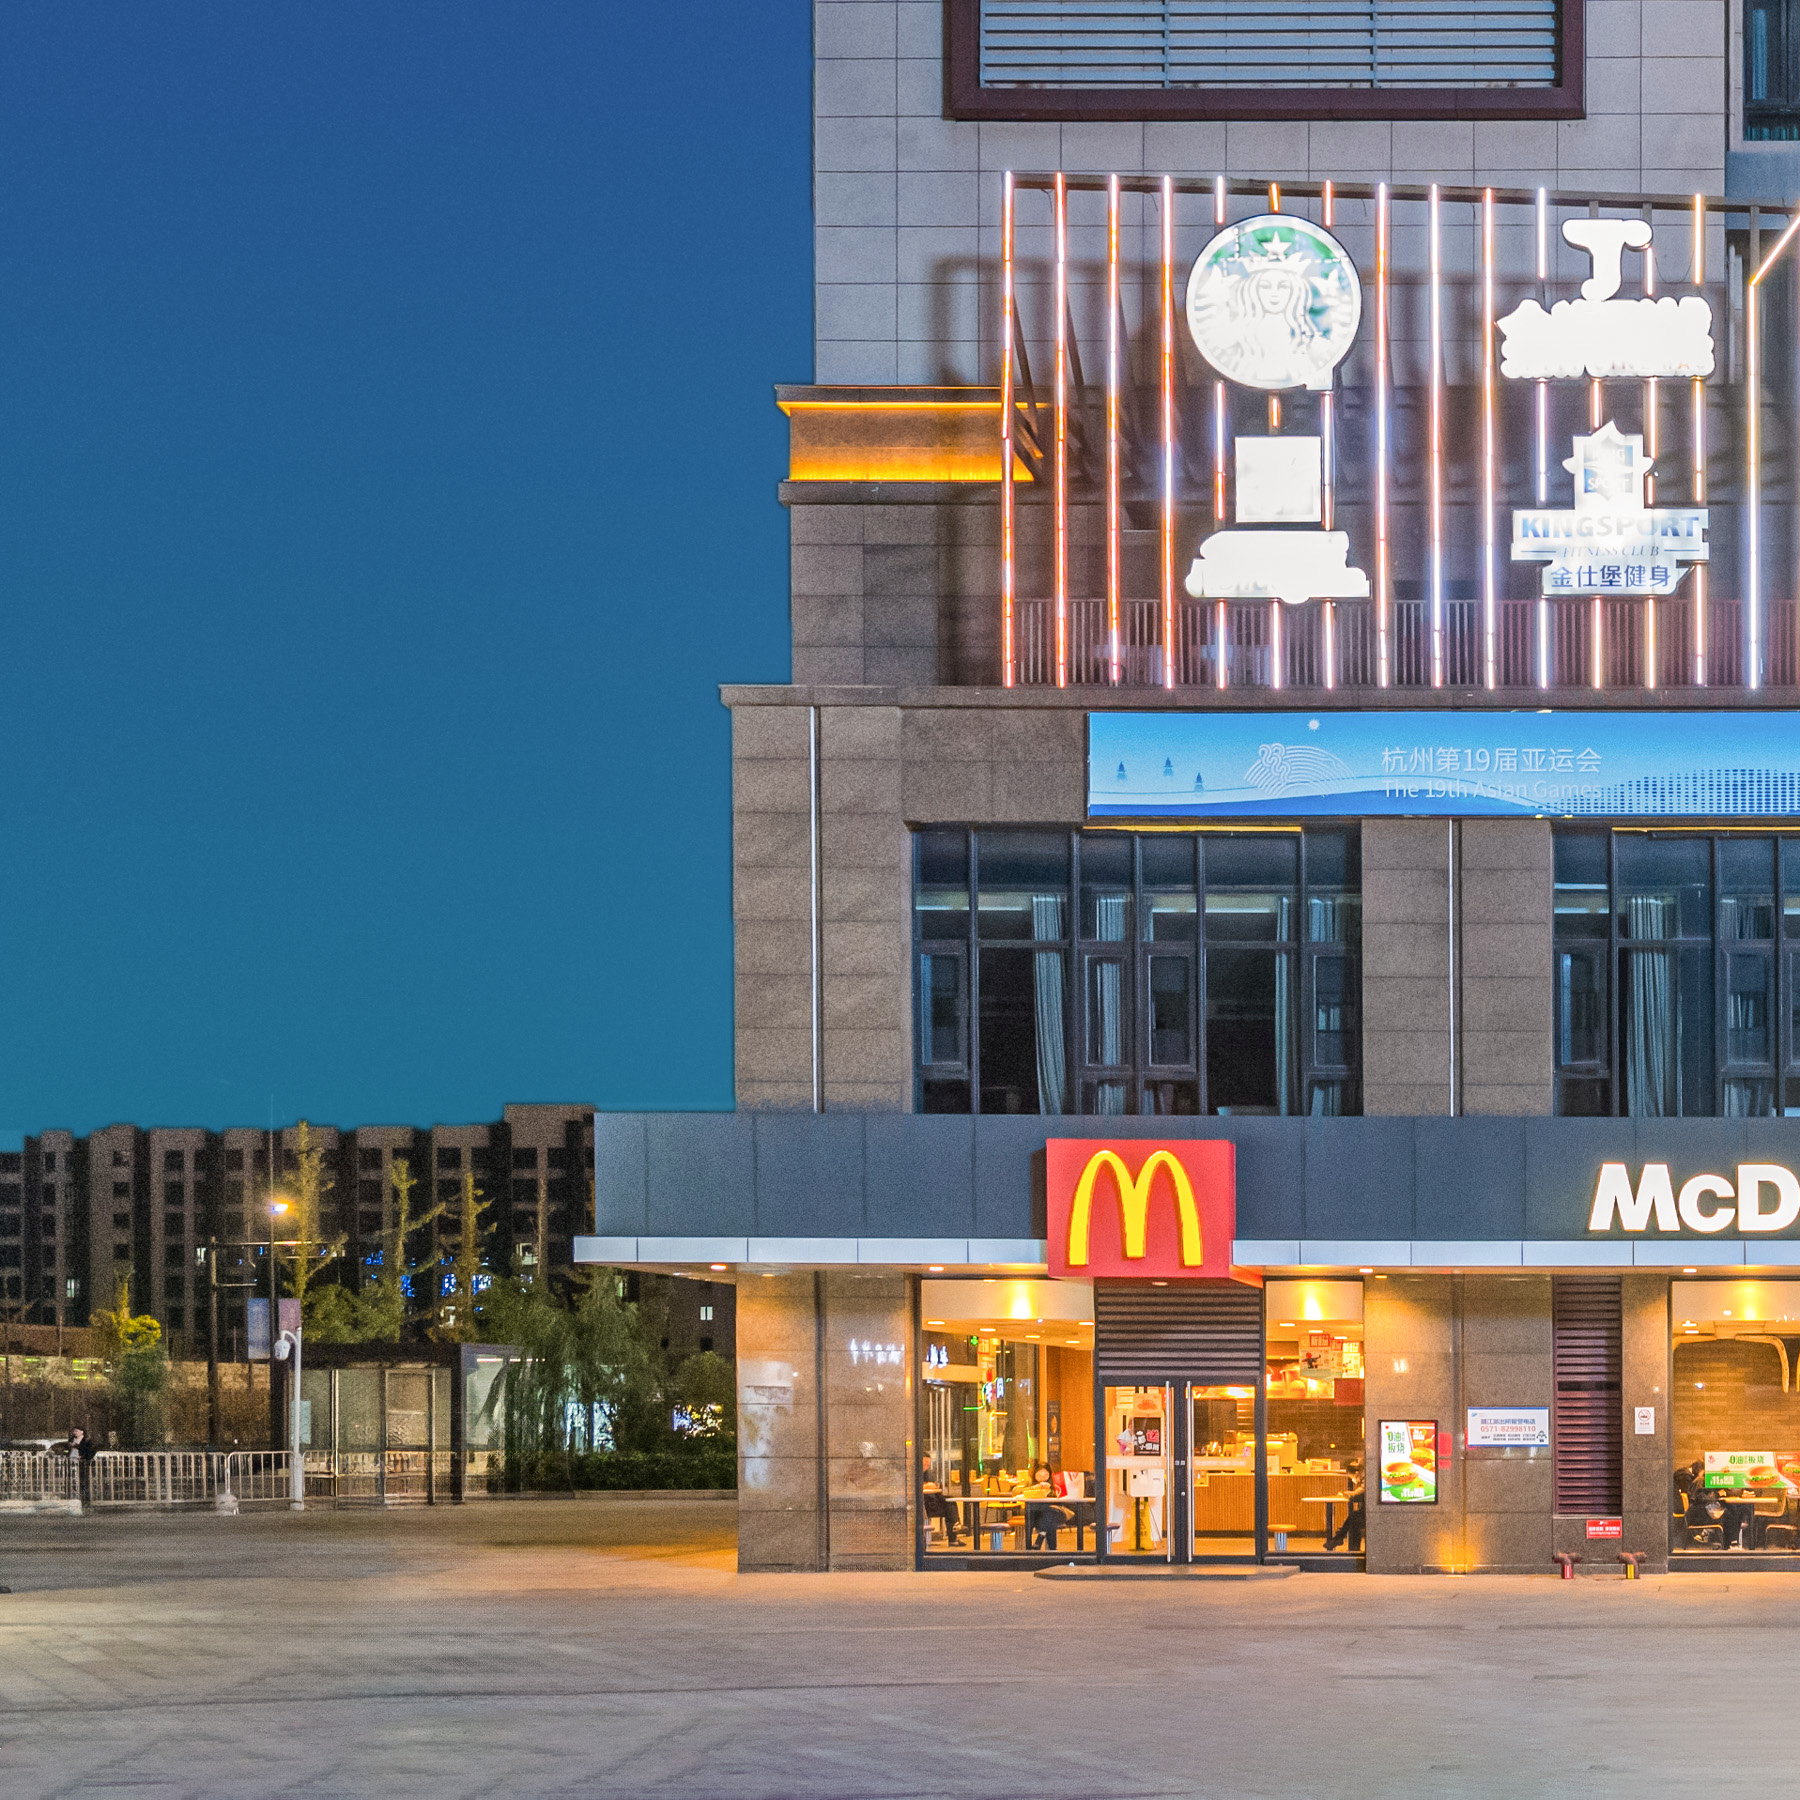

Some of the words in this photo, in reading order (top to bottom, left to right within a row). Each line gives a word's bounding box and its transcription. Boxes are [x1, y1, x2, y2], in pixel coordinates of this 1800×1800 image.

[1521, 516, 1699, 538] KINGSPORT
[1622, 545, 1659, 557] CLUB
[1551, 564, 1671, 588] 金仕堡健身
[1381, 747, 1602, 773] 杭州第19届亚运会
[1383, 780, 1418, 798] The
[1426, 780, 1468, 798] 19th
[1474, 780, 1527, 798] Asian
[1534, 780, 1601, 798] Games
